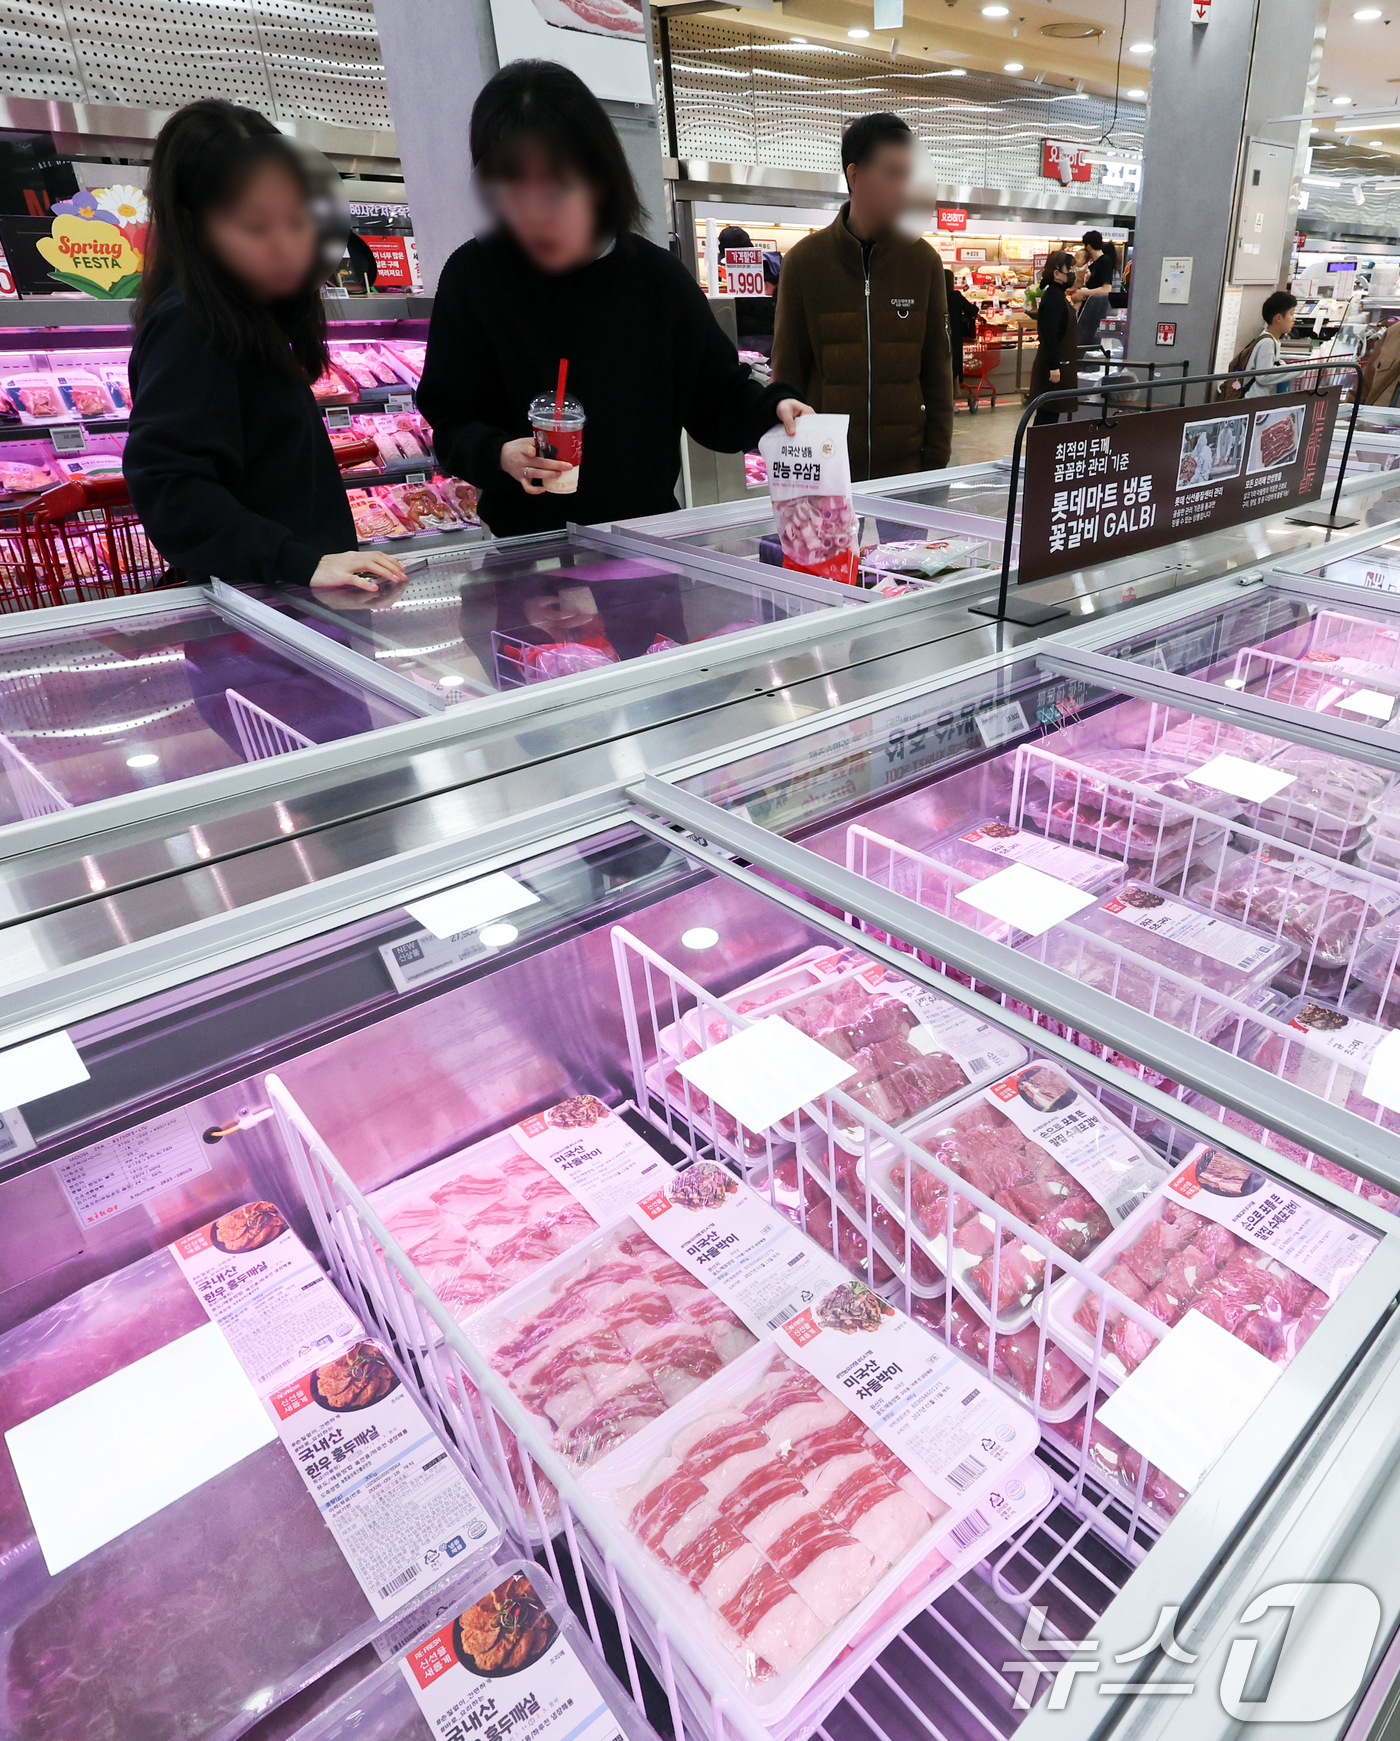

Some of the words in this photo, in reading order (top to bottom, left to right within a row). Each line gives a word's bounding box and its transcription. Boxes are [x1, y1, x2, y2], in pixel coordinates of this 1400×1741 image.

[58, 236, 122, 259] Spring
[731, 251, 756, 263] 가격할인
[73, 256, 122, 269] FESTA
[728, 272, 763, 295] 1,990
[782, 445, 800, 457] 미국산
[802, 446, 813, 458] 냉동
[1055, 440, 1088, 461] 최적의
[1089, 436, 1112, 456] 두께,
[773, 461, 791, 479] 만능
[793, 463, 821, 481] 우삼겹
[1054, 460, 1086, 483] 꼼꼼한
[1088, 456, 1108, 476] 관리
[1111, 453, 1130, 472] 기준
[1051, 482, 1118, 522] 롯데마트
[1122, 475, 1153, 506] 냉동
[1174, 496, 1185, 507] 롯데
[1213, 486, 1224, 498] 관리
[1048, 515, 1100, 554] 꽃갈비
[1103, 503, 1157, 538] GALBI
[396, 942, 415, 954] NEW
[398, 949, 420, 962] 신상품
[1039, 1121, 1064, 1139] 손으로
[1060, 1112, 1079, 1127] 포를
[554, 1143, 585, 1165] 미국산
[561, 1145, 602, 1174] 차돌박이
[1240, 1209, 1265, 1231] 손으로
[1258, 1198, 1277, 1215] 포를
[1266, 1199, 1302, 1230] 수제포갈비
[183, 1236, 205, 1250] 신선을
[686, 1230, 719, 1256] 미국산
[696, 1233, 739, 1265] 차돌박이
[196, 1266, 239, 1291] 국내산
[202, 1286, 227, 1303] 한우
[224, 1261, 269, 1290] 홍두깨살
[793, 1322, 811, 1337] 신선을
[842, 1359, 880, 1390] 미국산
[855, 1362, 903, 1400] 차돌박이
[280, 1389, 308, 1407] 신선을
[284, 1396, 309, 1414] 새롭게
[869, 1397, 884, 1410] 원산지
[910, 1406, 927, 1420] 2027년
[923, 1398, 935, 1409] 01월
[940, 1384, 951, 1394] 까지
[296, 1428, 346, 1462] 국내산
[304, 1455, 334, 1479] 한우
[328, 1425, 381, 1462] 홍두깨살
[315, 1464, 354, 1489] 용도/해동방법
[413, 1650, 424, 1659] RE:
[421, 1637, 442, 1652] FRESH
[416, 1646, 449, 1669] 신선을
[549, 1650, 566, 1665] 조리예
[421, 1655, 453, 1677] 새롭게
[444, 1698, 499, 1741] 국내산
[483, 1692, 541, 1741] 홍두깨살
